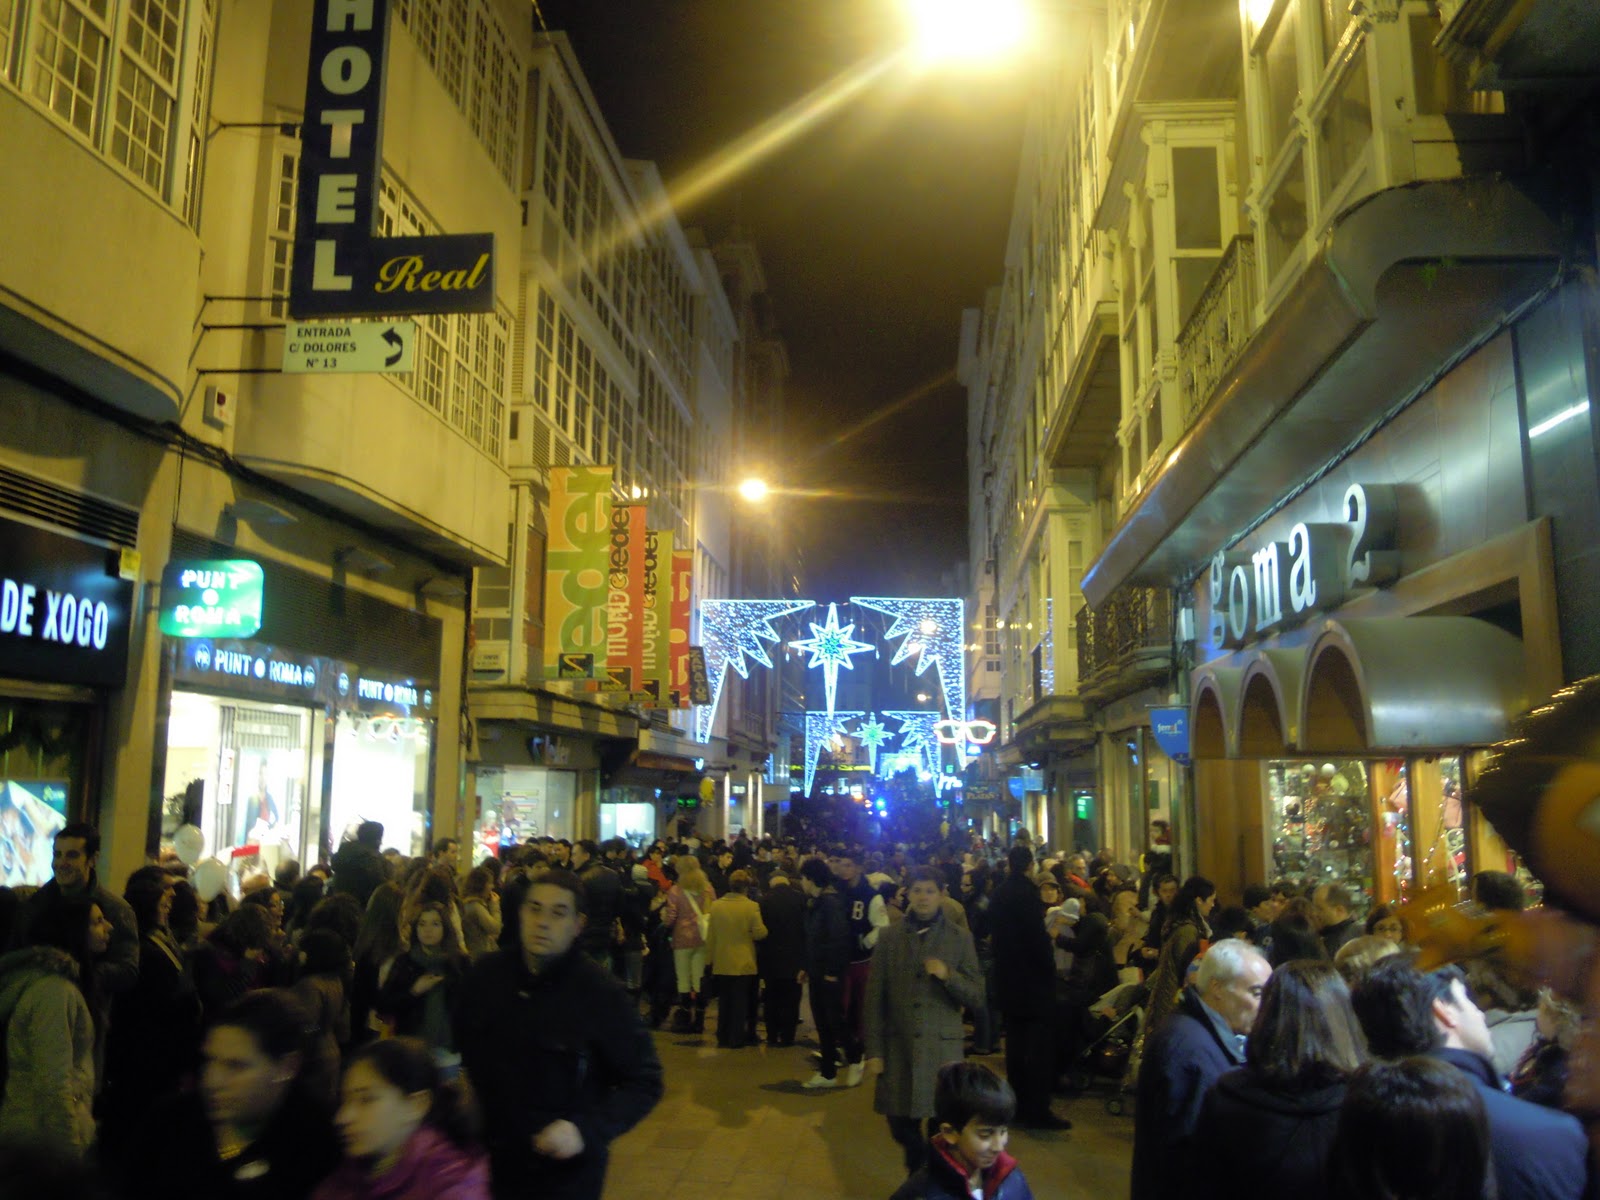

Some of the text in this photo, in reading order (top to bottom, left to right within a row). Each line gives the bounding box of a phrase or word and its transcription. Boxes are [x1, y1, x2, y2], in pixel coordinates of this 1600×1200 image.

[312, 0, 374, 291] HOTEL
[373, 253, 491, 294] Real
[297, 327, 352, 338] ENTRADA
[303, 342, 357, 353] DOLORES
[323, 358, 337, 368] 13
[1210, 483, 1371, 650] goma 2
[181, 569, 241, 589] PUNT
[0, 578, 109, 650] DE XOGO
[175, 604, 242, 625] ROMA
[214, 649, 252, 677] PUNT
[269, 659, 302, 686] ROMA
[358, 677, 384, 700] PUNT
